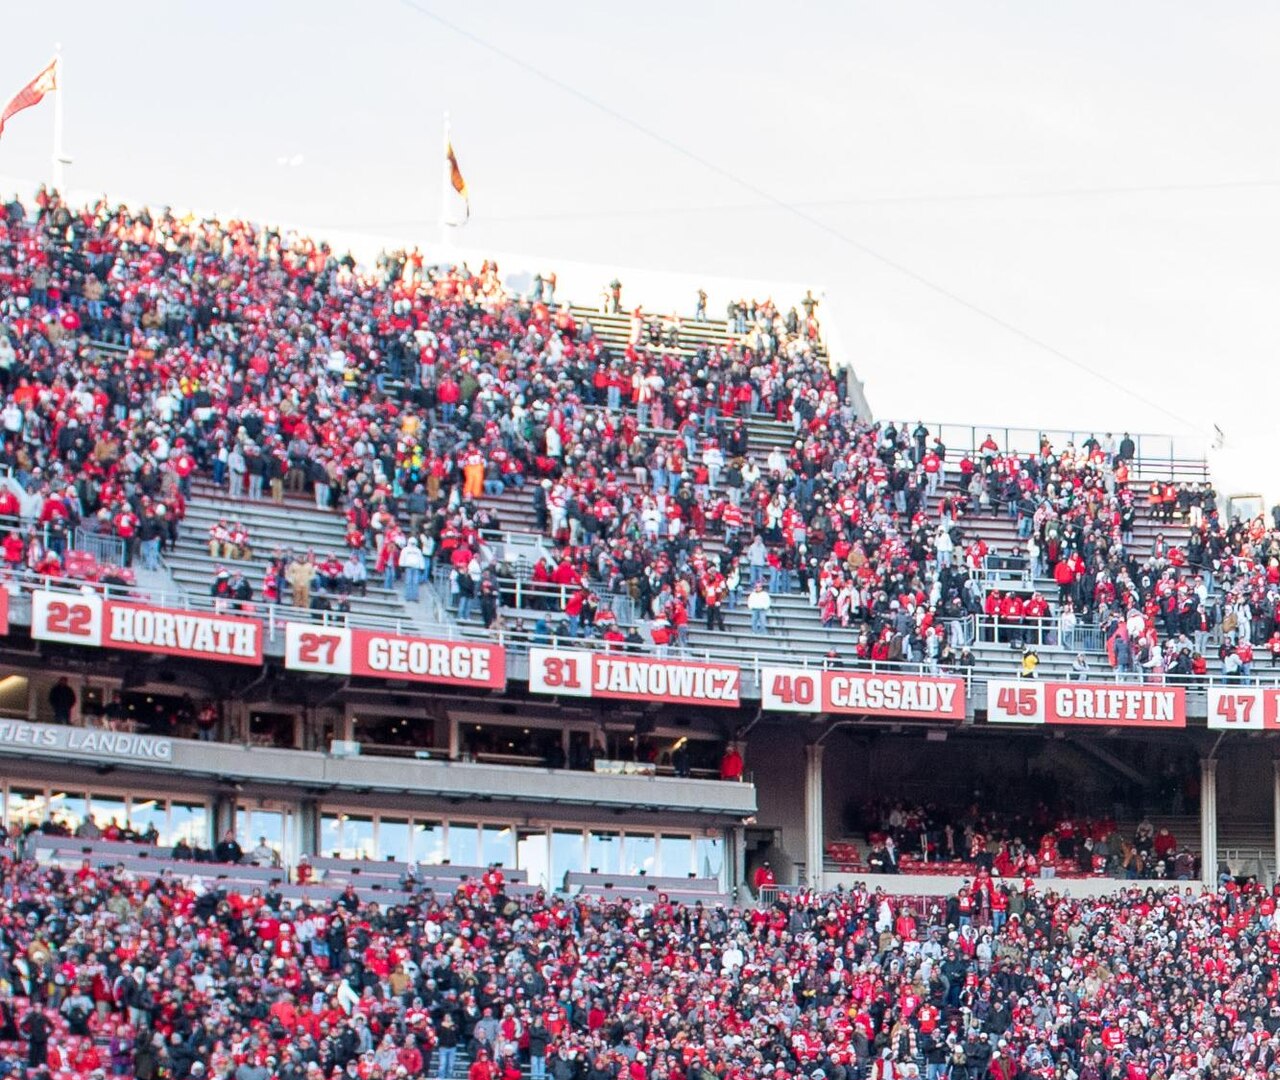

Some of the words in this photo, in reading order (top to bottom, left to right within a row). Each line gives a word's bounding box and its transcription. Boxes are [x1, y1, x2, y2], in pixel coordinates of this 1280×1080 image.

[47, 601, 91, 636] 22
[110, 606, 256, 657] HORVATH
[299, 633, 341, 665] 27
[368, 637, 491, 681] GEORGE
[543, 657, 581, 688] 31
[594, 659, 739, 700] JANOWICZ
[772, 674, 814, 705] 40
[830, 676, 957, 713] CASSADY
[997, 688, 1037, 716] 45
[1055, 687, 1176, 721] GRIFFIN
[1216, 694, 1256, 722] 47
[67, 732, 170, 759] LANDING
